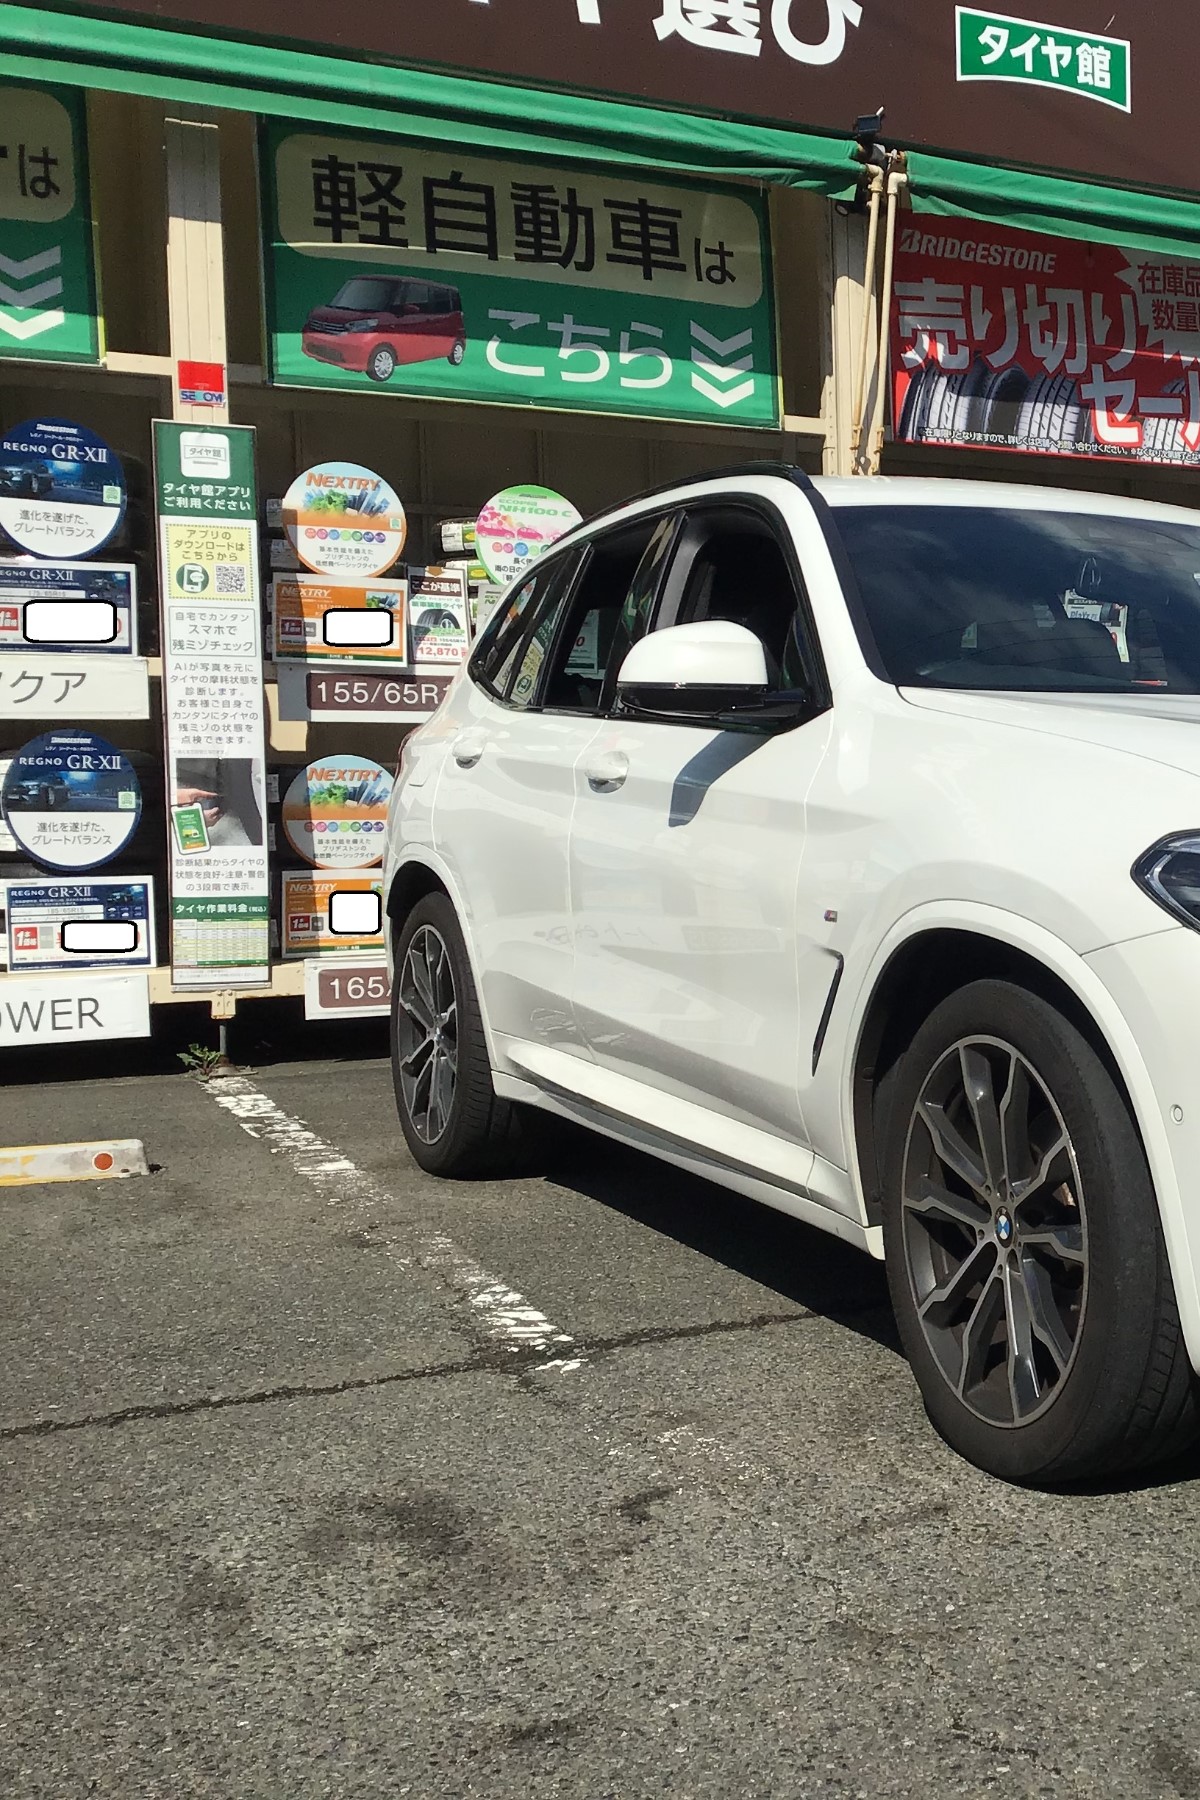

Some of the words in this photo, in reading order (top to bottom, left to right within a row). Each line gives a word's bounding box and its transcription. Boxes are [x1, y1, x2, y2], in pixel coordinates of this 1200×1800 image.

[978, 25, 1112, 89] タイヤ館
[0, 144, 60, 198] は
[310, 155, 737, 285] 軽自動車は
[899, 229, 1057, 274] BRIDGESTONE
[894, 277, 1137, 375] 売り切り
[486, 308, 674, 388] こちら
[181, 390, 223, 403] SEOM
[3, 441, 47, 453] REGNO
[189, 447, 222, 458] タイヤ館
[305, 472, 382, 491] NEXTRY
[163, 483, 250, 498] タイヤ館アプリ
[164, 496, 250, 511] ご利用ください
[499, 504, 558, 515] NH100
[14, 523, 95, 539] グレートバランス
[186, 529, 232, 540] アプリの
[174, 539, 245, 551] ダウンロードは
[182, 550, 238, 561] こちらから
[282, 586, 331, 598] NEXTRY
[188, 624, 237, 636] スマホで
[418, 647, 459, 657] 12,870
[0, 670, 87, 703] クア
[19, 757, 62, 766] REGNO
[308, 767, 383, 782] NEXTRY
[32, 835, 113, 845] グレートバランス
[10, 889, 45, 897] REGNO
[289, 883, 338, 893] NEXTRY
[0, 996, 104, 1034] WER
